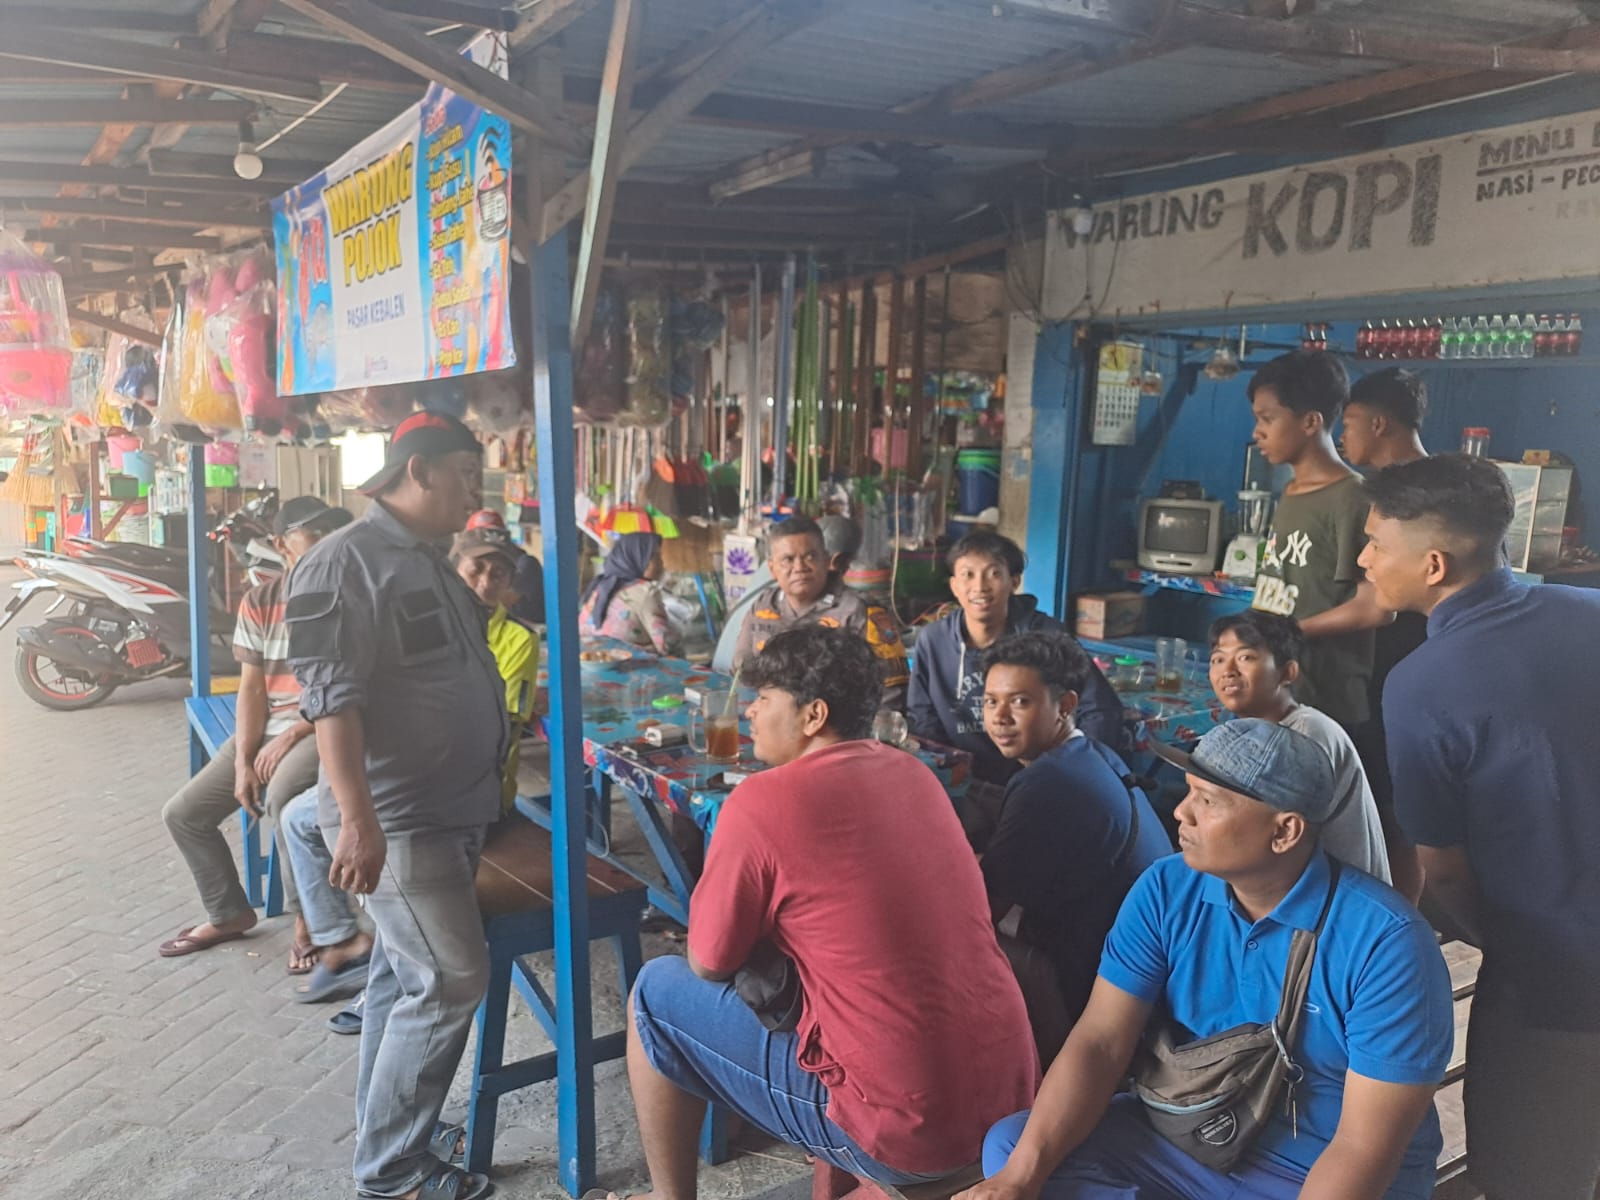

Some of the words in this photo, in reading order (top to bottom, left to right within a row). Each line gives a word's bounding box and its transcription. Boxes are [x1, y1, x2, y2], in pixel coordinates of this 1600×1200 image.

[1478, 126, 1576, 168] MENU
[323, 140, 413, 238] WARUNG
[1476, 169, 1534, 202] NASI
[1057, 188, 1225, 249] WARUNG
[1242, 154, 1442, 260] KOPI
[342, 209, 402, 287] POJOK
[346, 303, 369, 329] PASAR
[1279, 530, 1313, 568] NY
